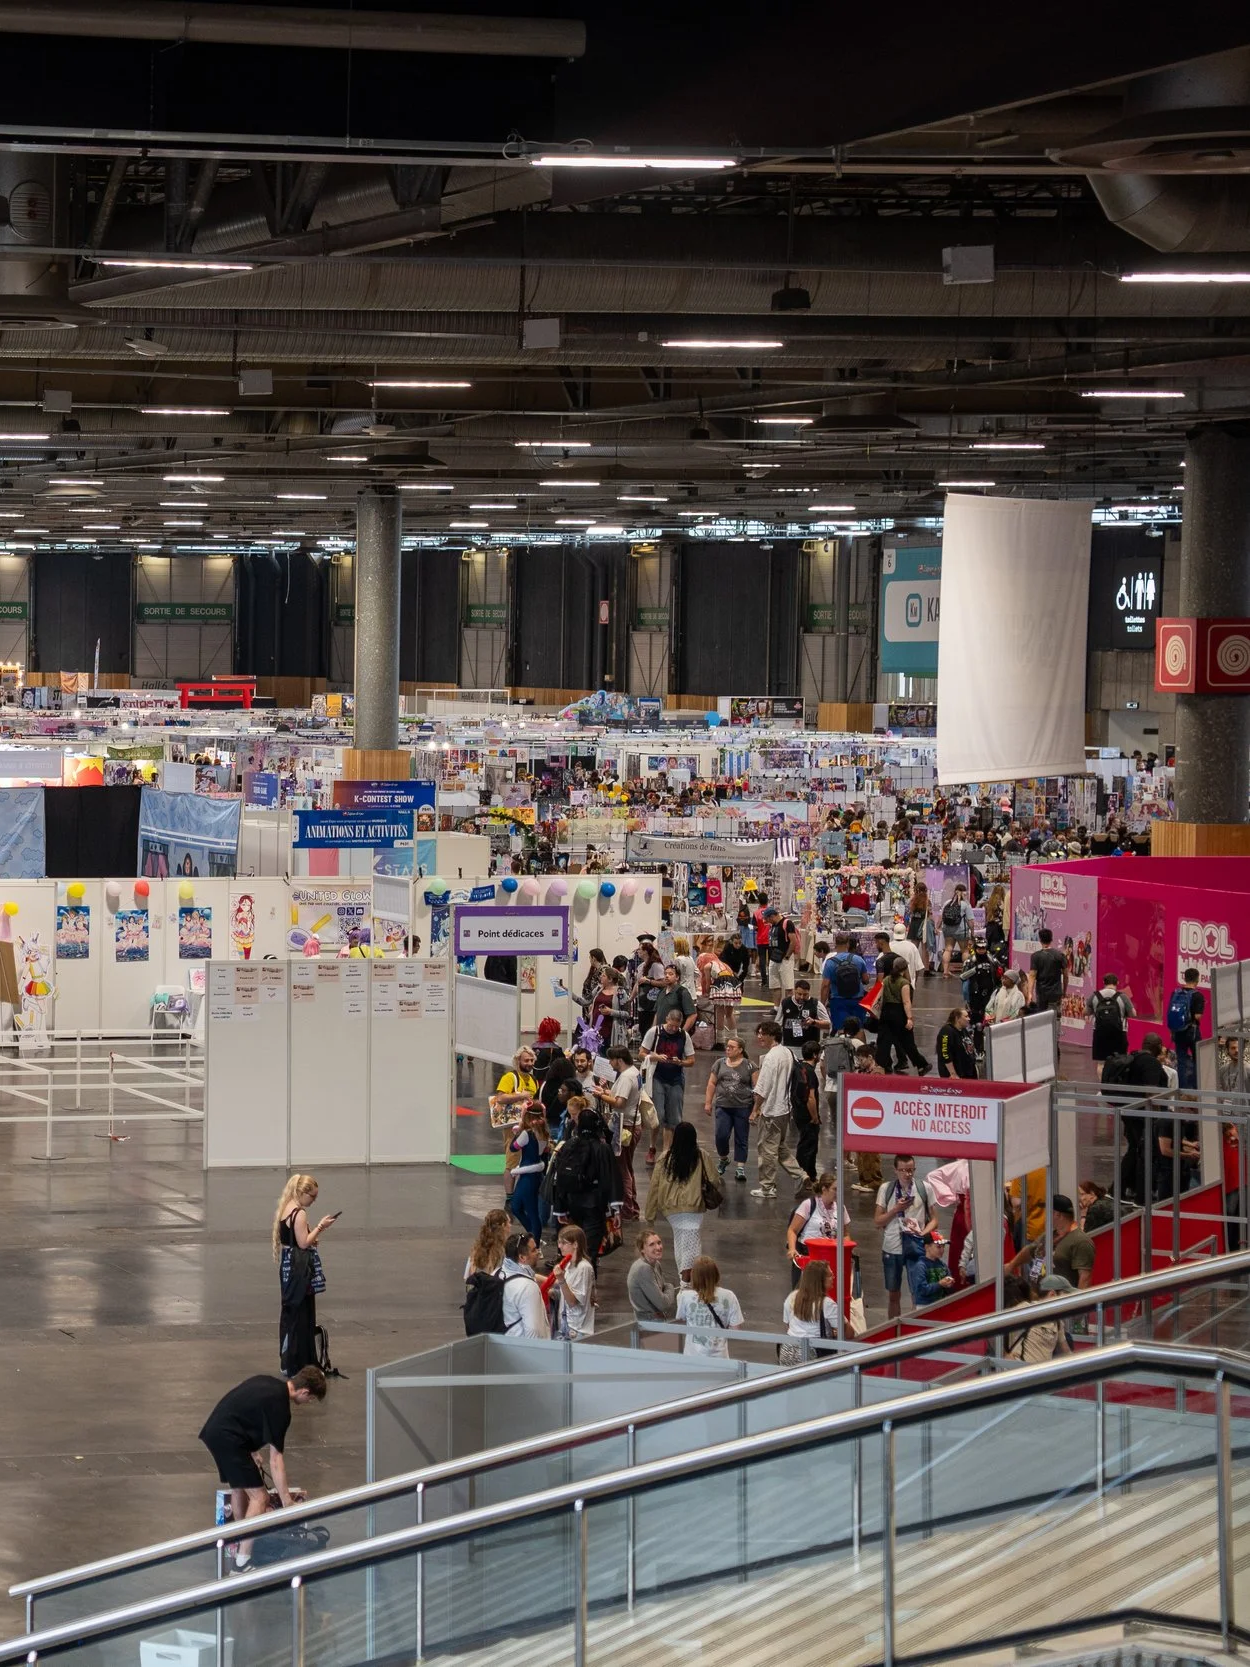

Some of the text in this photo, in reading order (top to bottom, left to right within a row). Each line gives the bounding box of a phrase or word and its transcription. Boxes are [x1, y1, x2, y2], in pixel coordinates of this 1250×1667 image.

[144, 607, 171, 615] SORTIE
[471, 609, 484, 618] SORTIE
[492, 609, 506, 618] SECOU
[927, 597, 940, 622] KA
[813, 611, 832, 620] SORTIE
[142, 680, 168, 689] Hall 6
[354, 795, 414, 803] K-CONTEST SHOW
[305, 823, 408, 838] ANIMATIONS ET ACTIVITÉS
[665, 841, 698, 850] Créations
[710, 843, 726, 851] fans
[1040, 873, 1067, 894] IDOL
[478, 929, 544, 938] Point dédicaces
[1180, 920, 1235, 960] IDOL
[893, 1099, 988, 1120] ACCÈS INTERDIT
[911, 1119, 971, 1135] NO ACCESS
